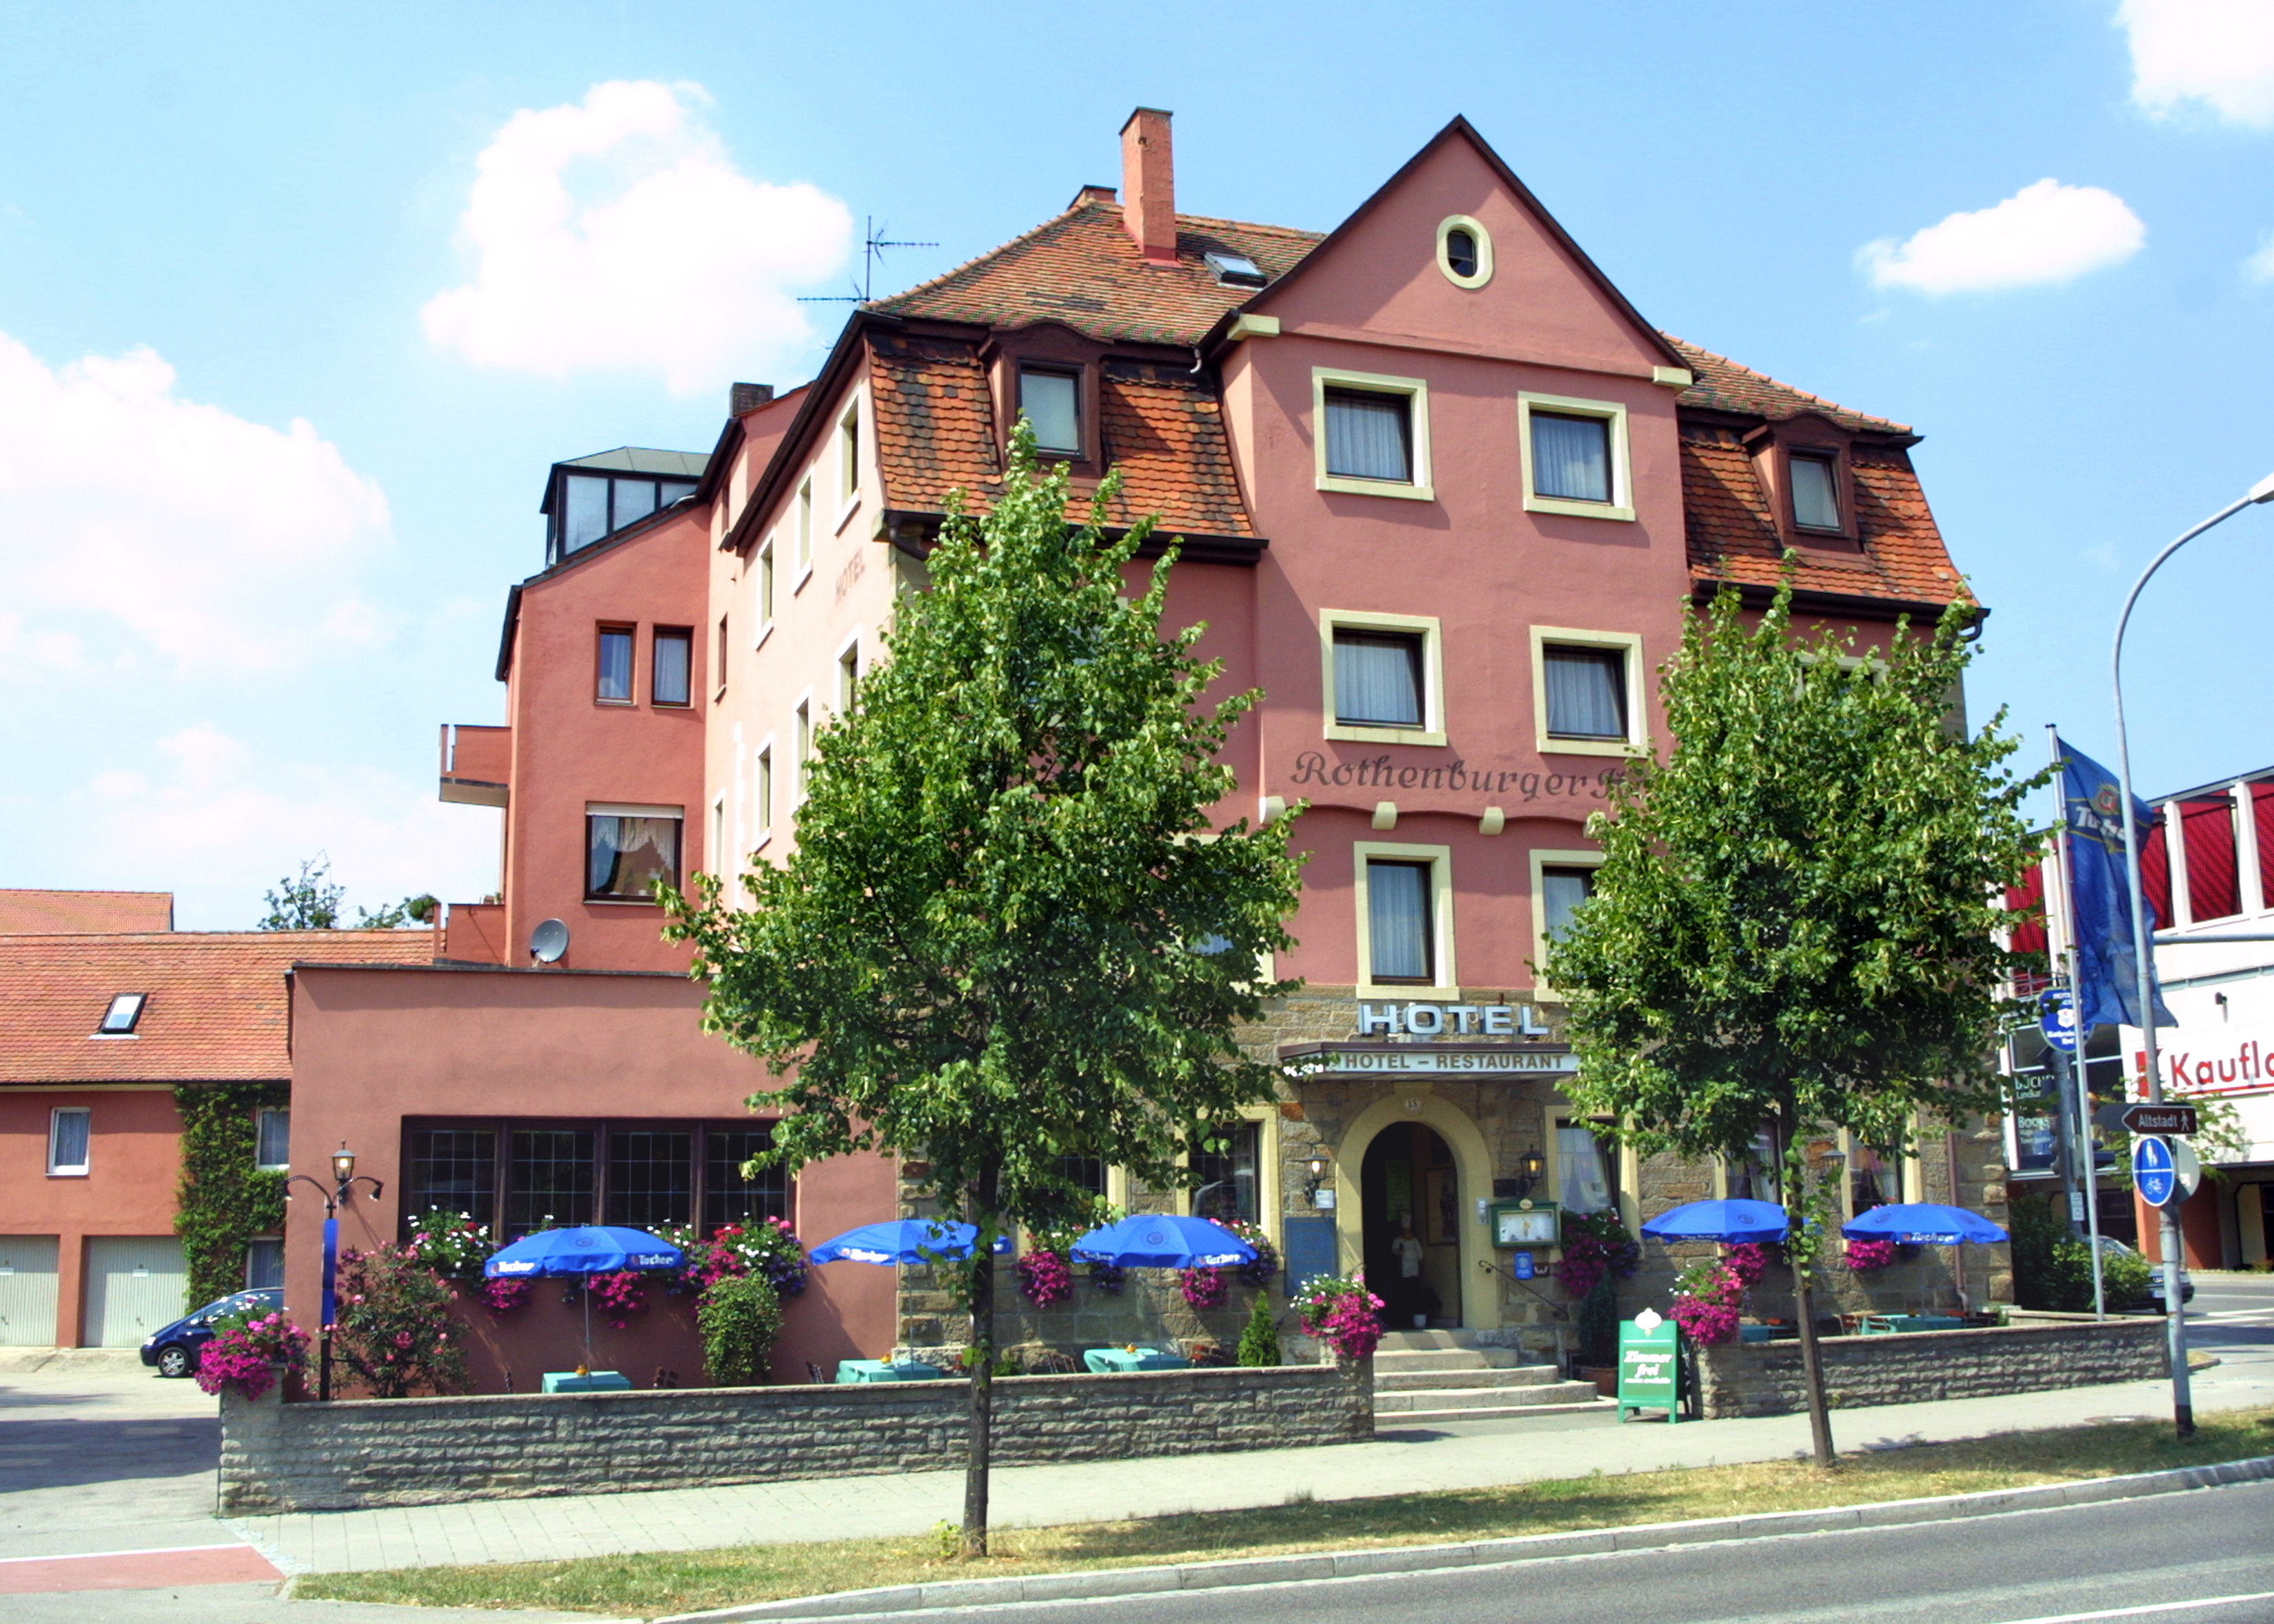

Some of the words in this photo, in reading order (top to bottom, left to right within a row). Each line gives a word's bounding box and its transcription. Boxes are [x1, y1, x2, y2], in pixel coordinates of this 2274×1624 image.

[835, 547, 866, 607] HOTEL
[1290, 751, 1587, 802] Rothenburger
[1358, 1002, 1549, 1035] HOTEL
[1345, 1054, 1410, 1068] HOTEL
[1436, 1054, 1564, 1069] RESTAURANT
[2138, 1114, 2178, 1128] Altstadt
[638, 1254, 674, 1266] Tucher
